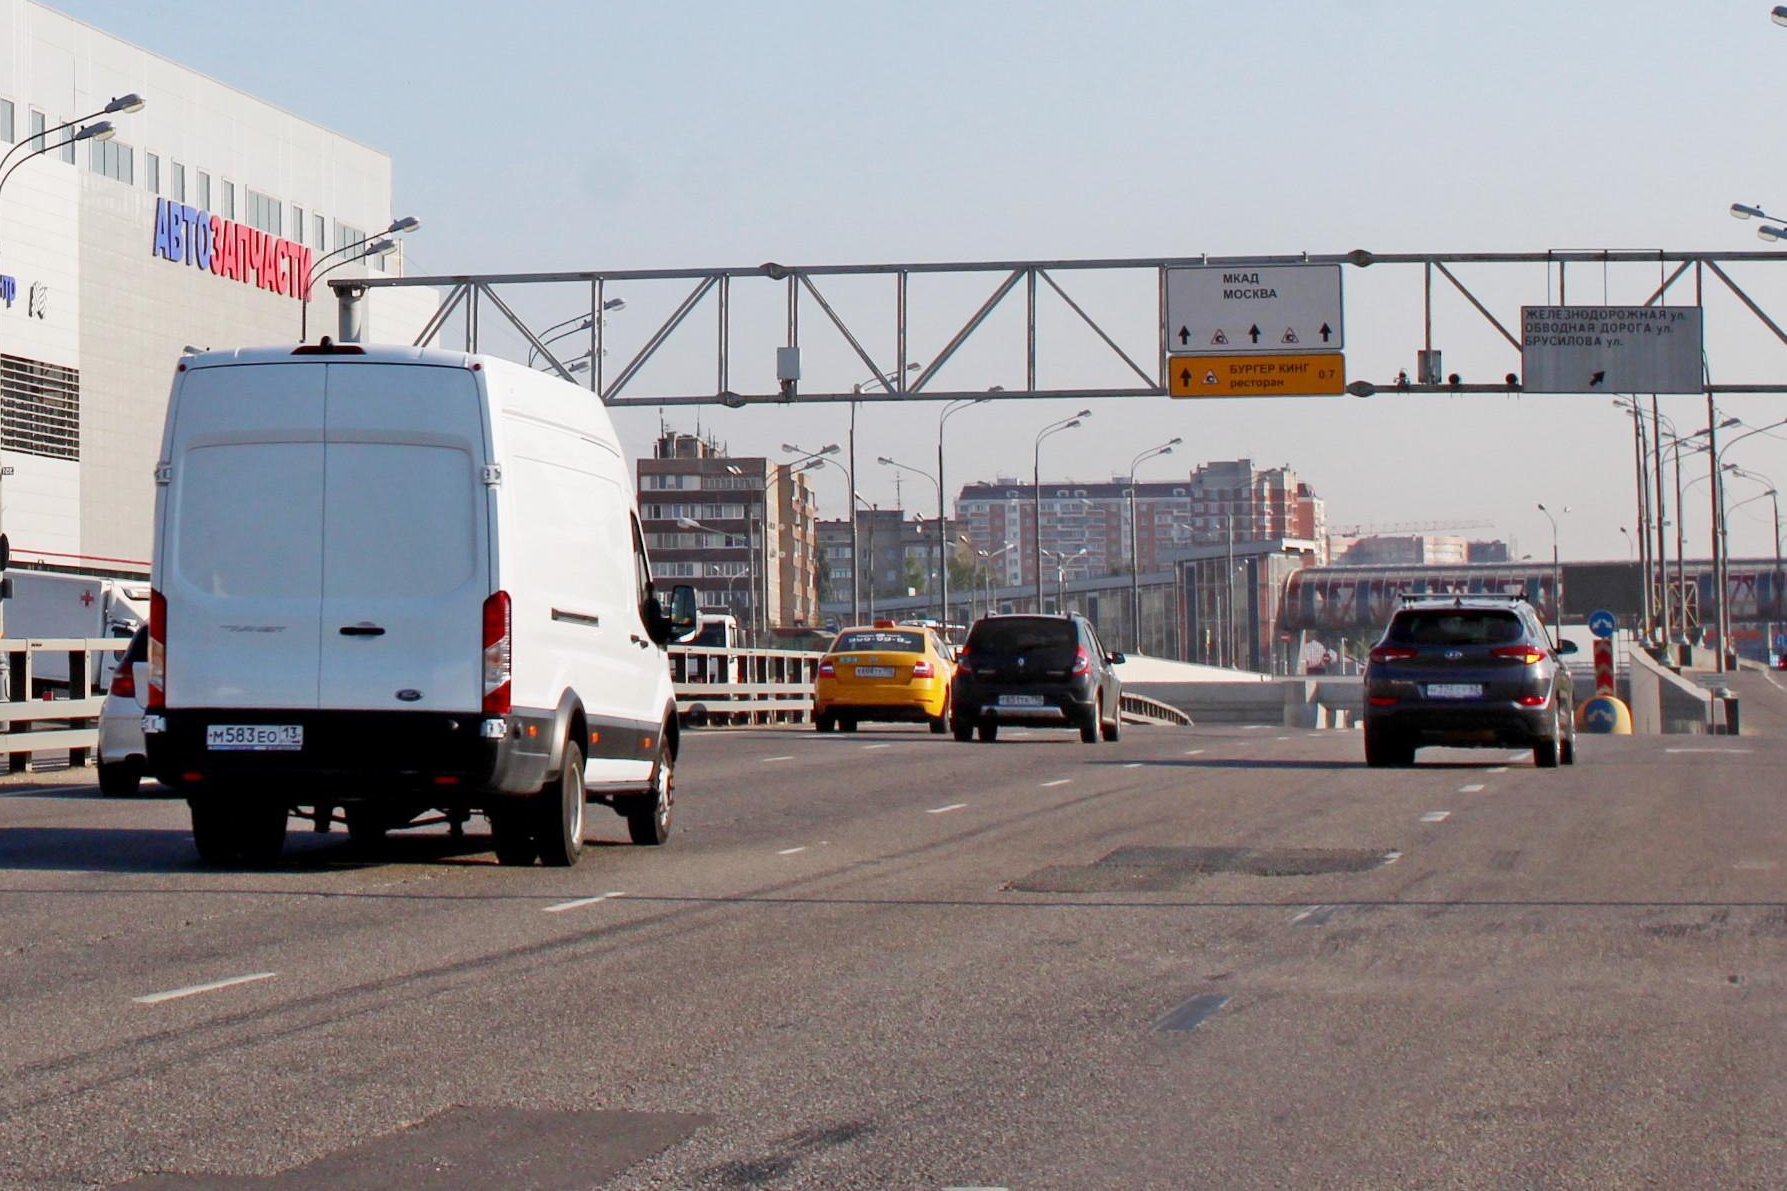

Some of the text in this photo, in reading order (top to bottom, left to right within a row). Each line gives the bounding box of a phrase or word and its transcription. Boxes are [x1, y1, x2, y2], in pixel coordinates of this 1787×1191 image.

[153, 197, 312, 302] АВТОЗАПЧАСТИ
[1223, 273, 1259, 285] МКАД
[1223, 288, 1277, 300] МОСКВА
[1525, 310, 1687, 322] ЖЕЛЕЗНОДОРОЖНАЯ ул.
[1525, 322, 1674, 336] ОБВОДНАЯ ДОРОГА ул.
[1525, 336, 1623, 348] БРУСИЛОВА ул.
[1230, 363, 1275, 374] БУРГЕР
[1279, 362, 1310, 373] КИНГ
[1230, 378, 1284, 390] ресторан
